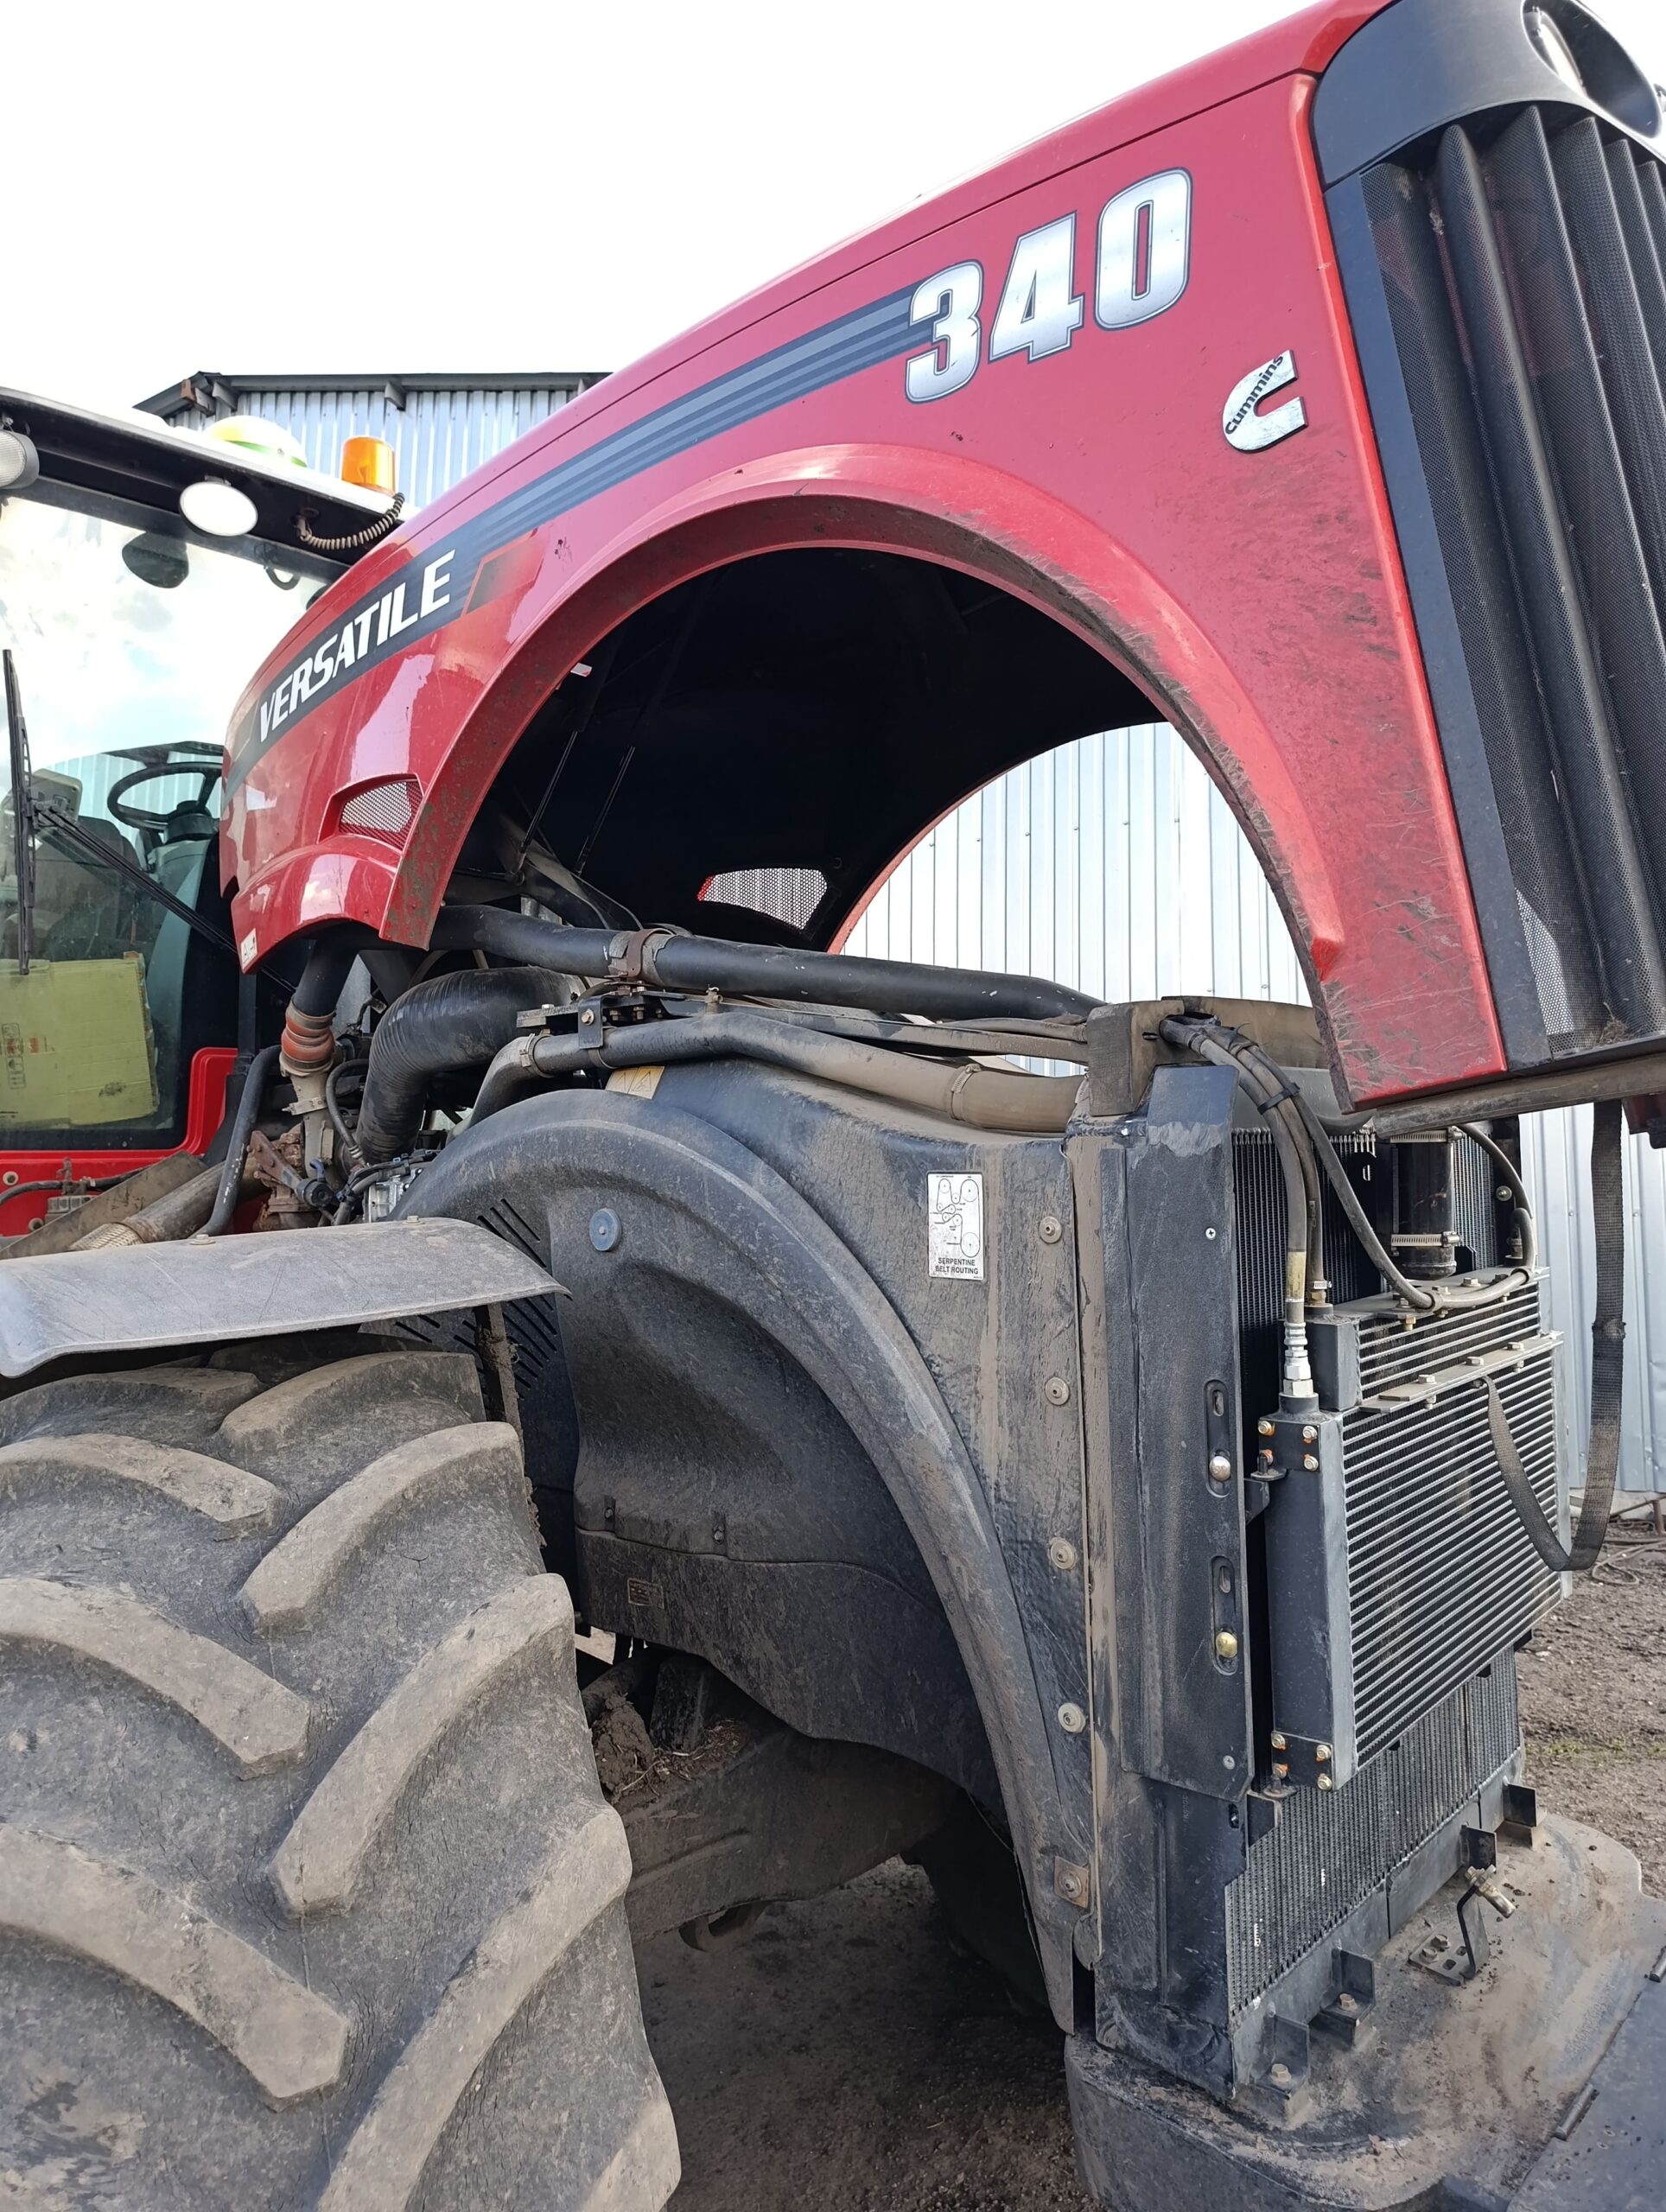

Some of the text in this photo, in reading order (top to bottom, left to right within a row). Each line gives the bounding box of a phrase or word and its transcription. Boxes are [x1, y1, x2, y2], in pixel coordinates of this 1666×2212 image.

[905, 167, 1192, 404] 340
[1224, 356, 1284, 435] Cummins
[260, 549, 456, 743] VERSATILE
[938, 1257, 976, 1266] SERPENTINE
[951, 1266, 978, 1274] ROUTING
